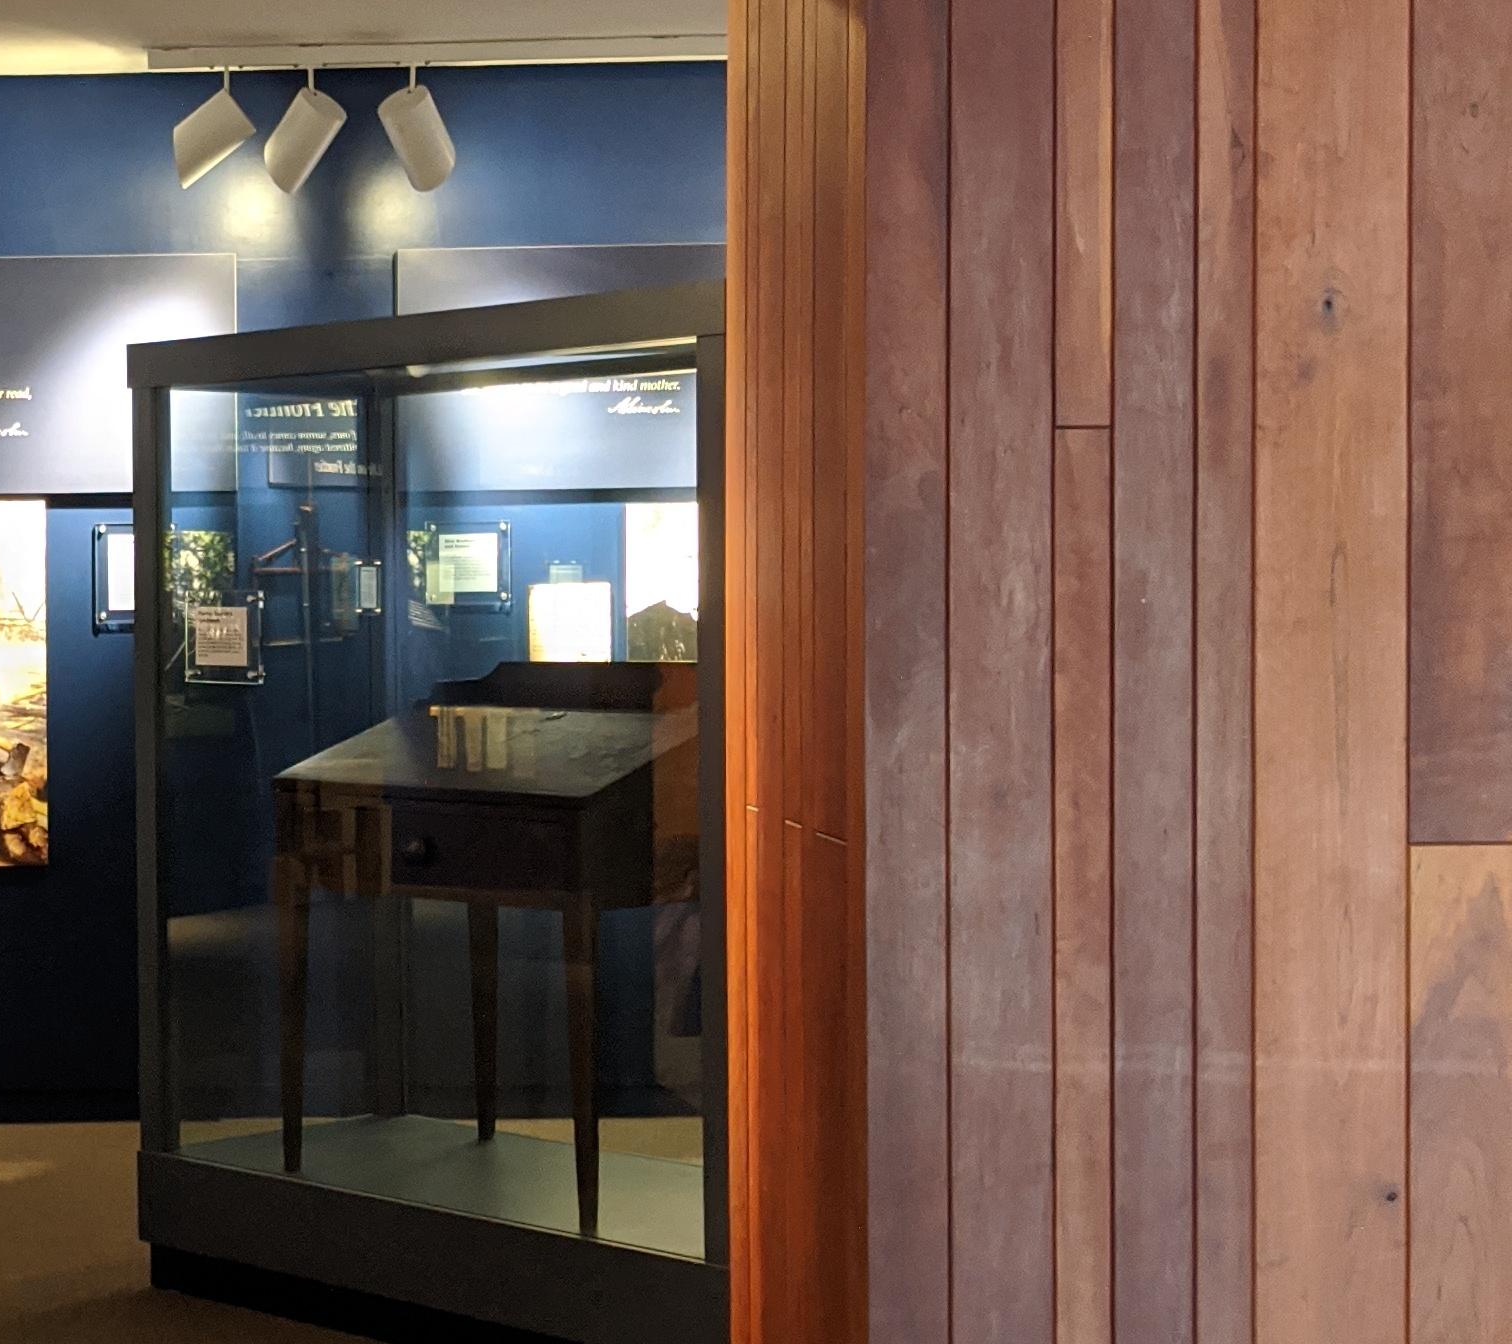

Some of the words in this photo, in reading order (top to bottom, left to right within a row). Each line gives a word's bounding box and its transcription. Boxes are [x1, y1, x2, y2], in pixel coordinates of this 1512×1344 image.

[589, 380, 612, 393] and
[612, 379, 638, 392] kind
[639, 379, 681, 392] mother.
